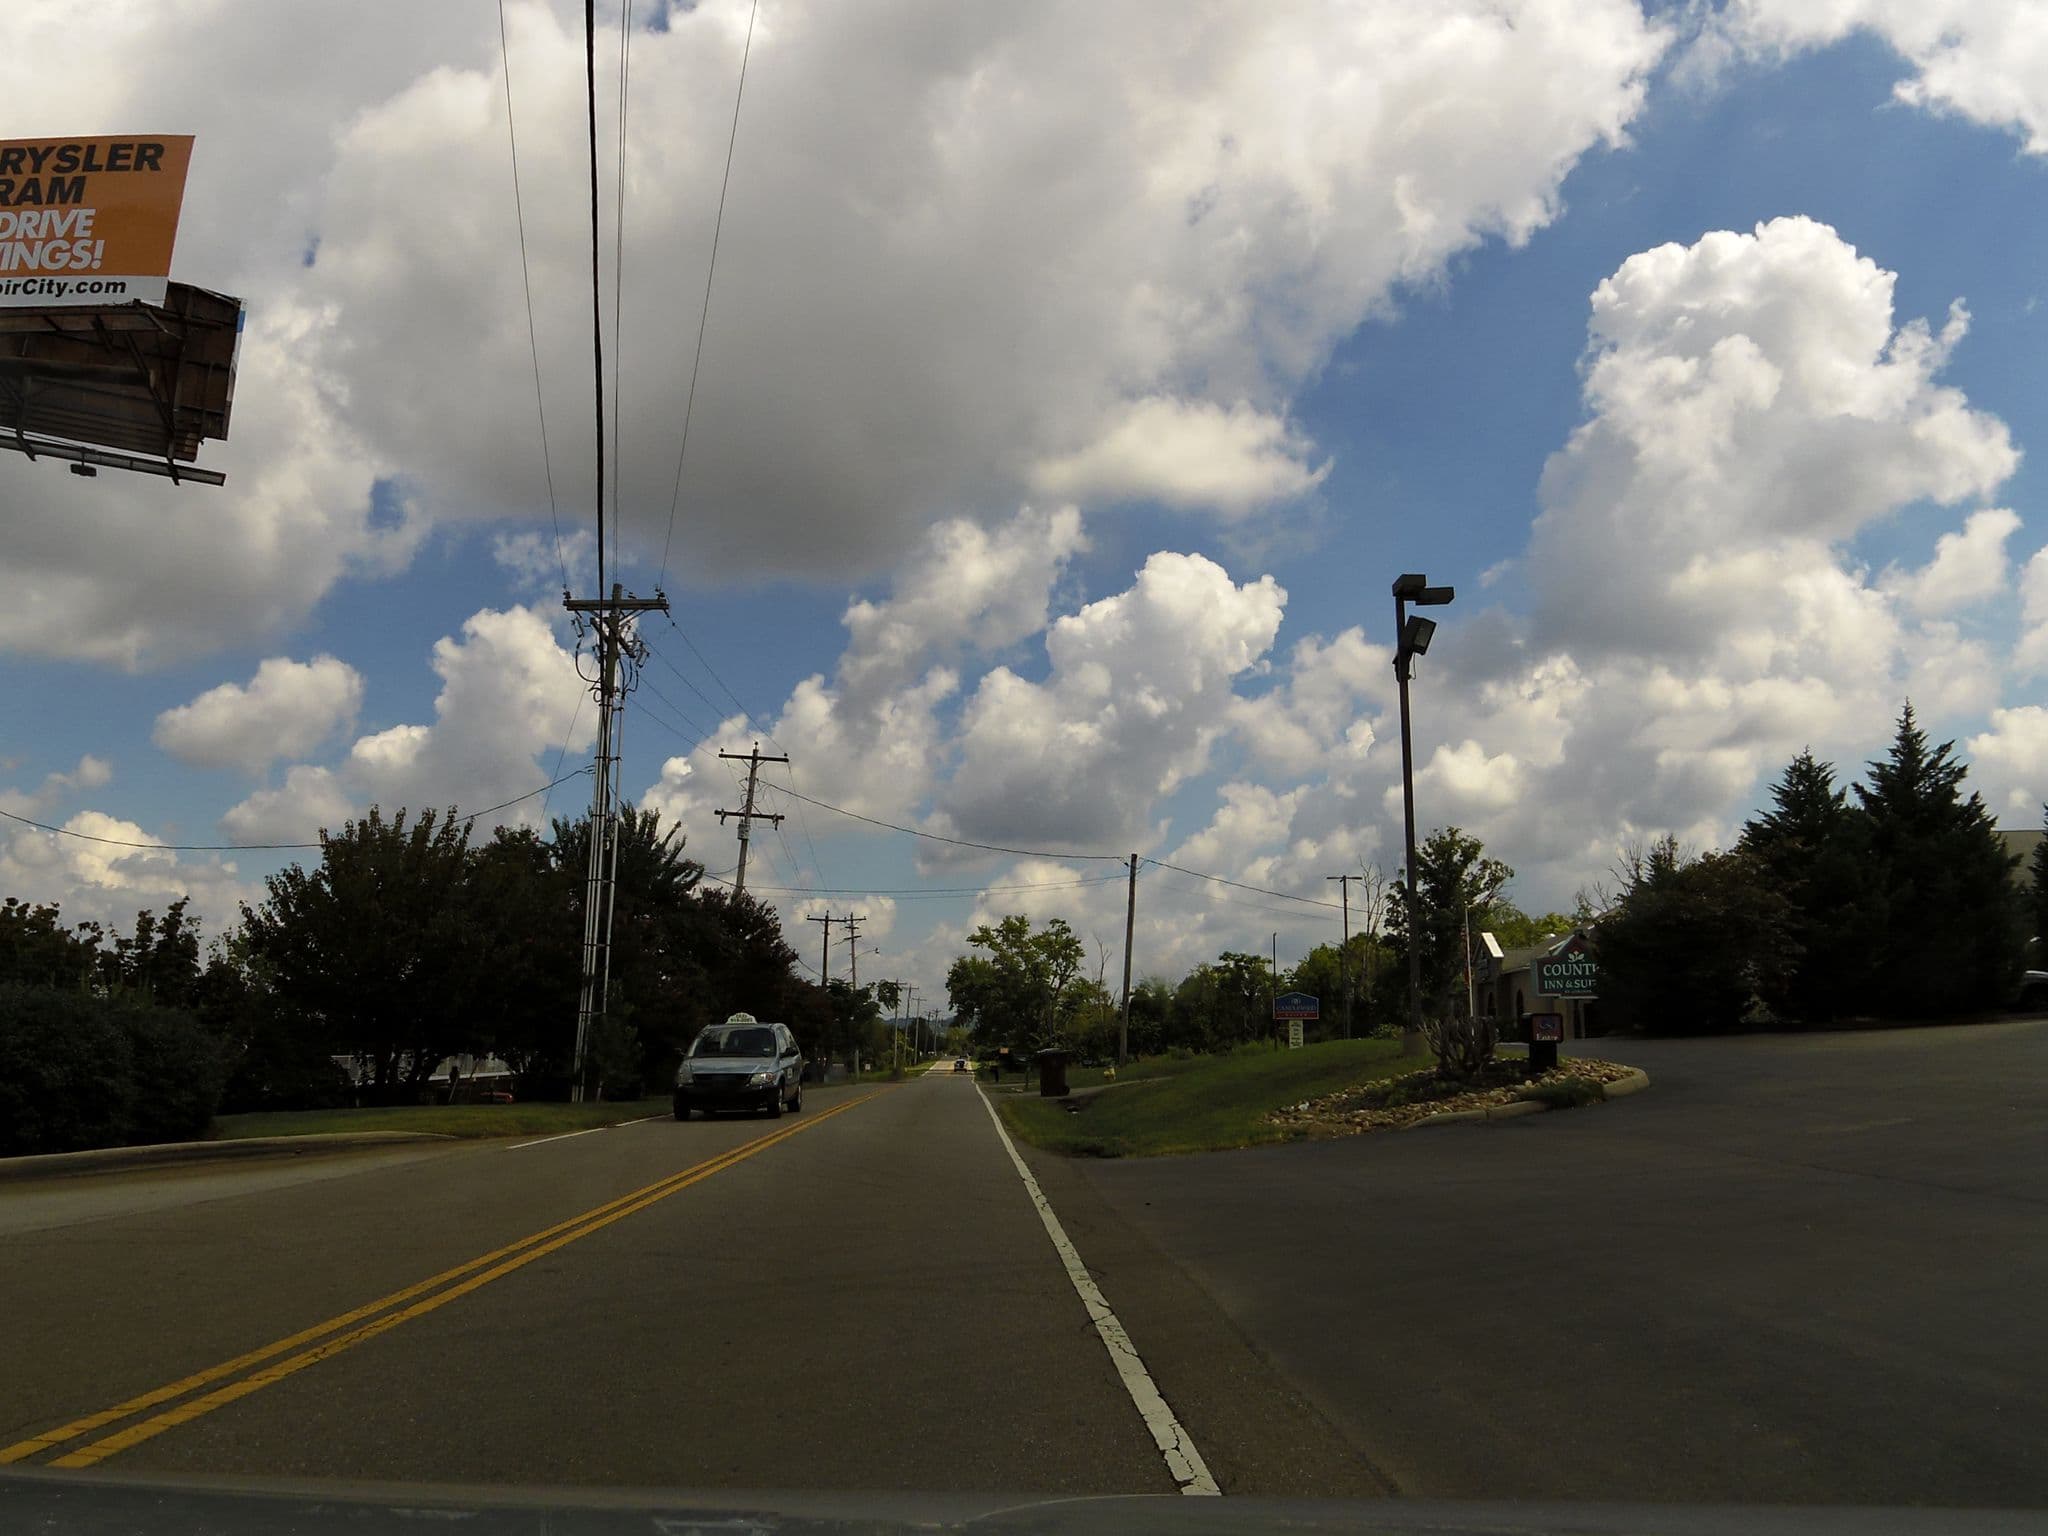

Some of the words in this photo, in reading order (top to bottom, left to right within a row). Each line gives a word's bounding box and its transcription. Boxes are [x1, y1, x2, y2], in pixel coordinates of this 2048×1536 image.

[0, 143, 164, 175] RYSLER
[0, 176, 86, 206] RAM
[0, 208, 96, 239] DRIVE
[0, 239, 105, 271] INGS!
[0, 278, 127, 298] irCity.com
[1544, 979, 1563, 989] INN
[1565, 979, 1573, 988] &
